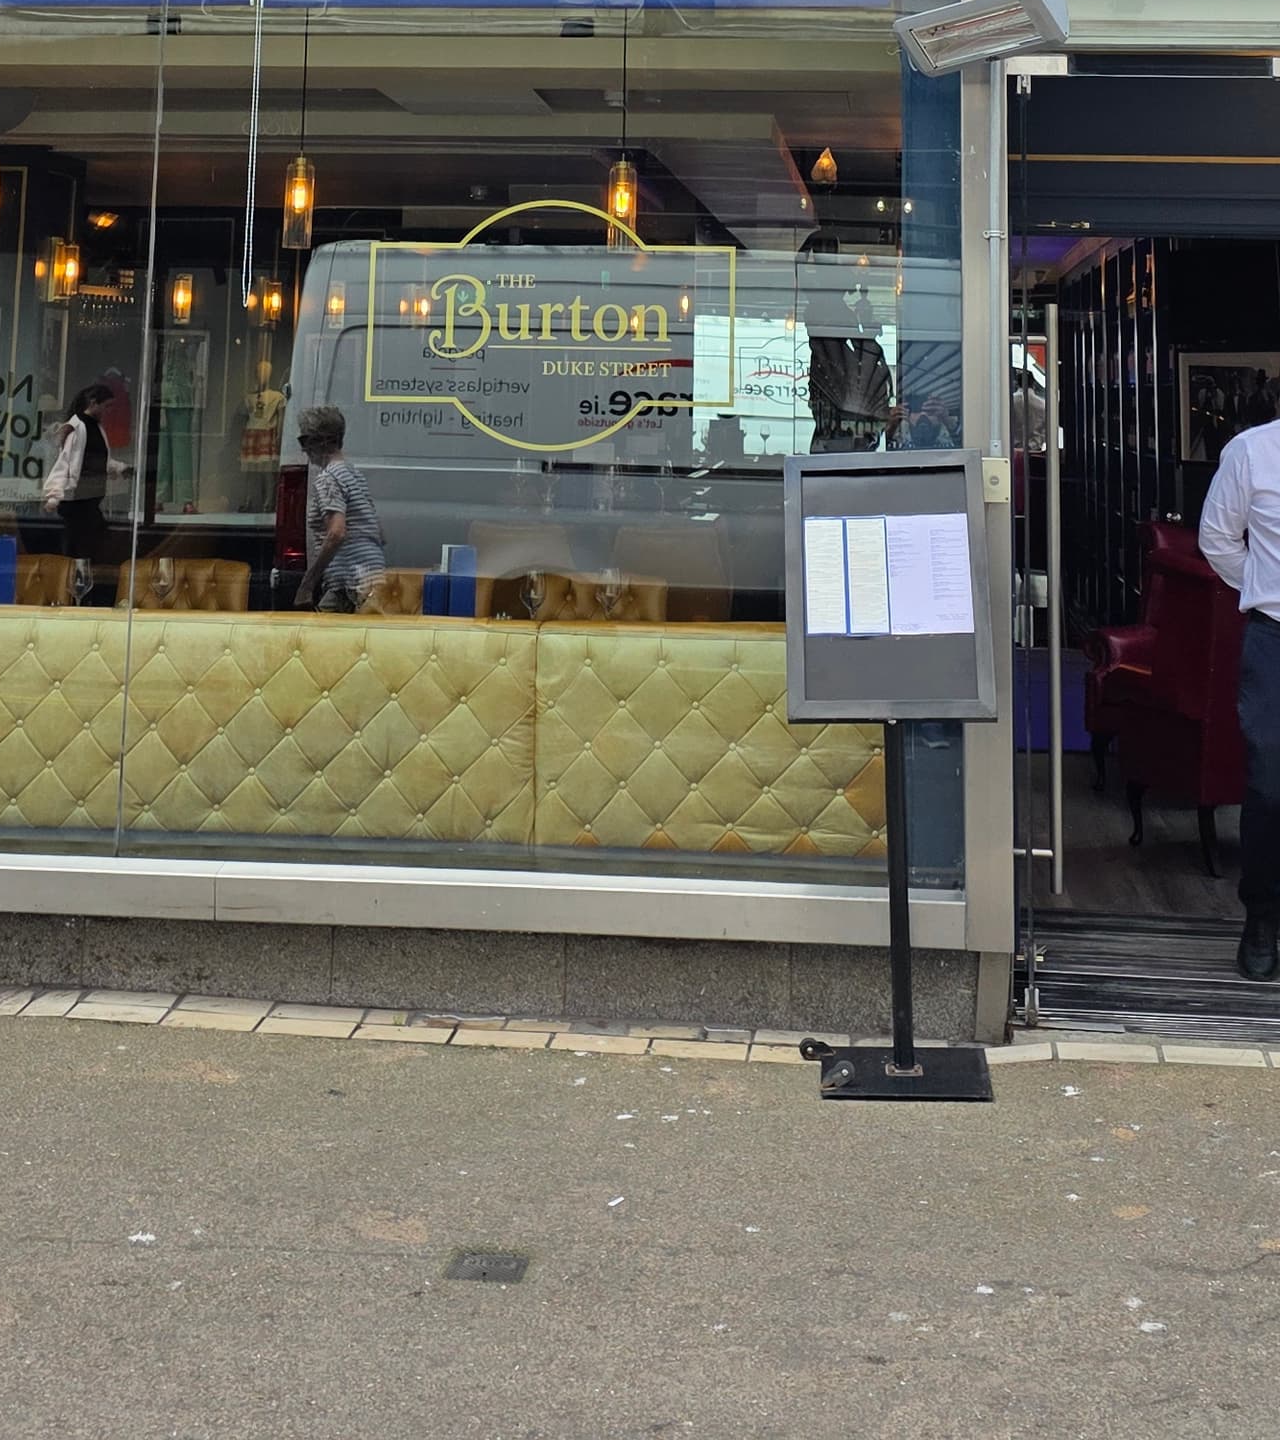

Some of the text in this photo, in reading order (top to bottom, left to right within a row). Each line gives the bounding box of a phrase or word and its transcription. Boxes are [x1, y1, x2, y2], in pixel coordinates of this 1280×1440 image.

[495, 273, 537, 289] THE
[427, 273, 673, 359] Burton
[541, 360, 672, 378] DUKE STREET
